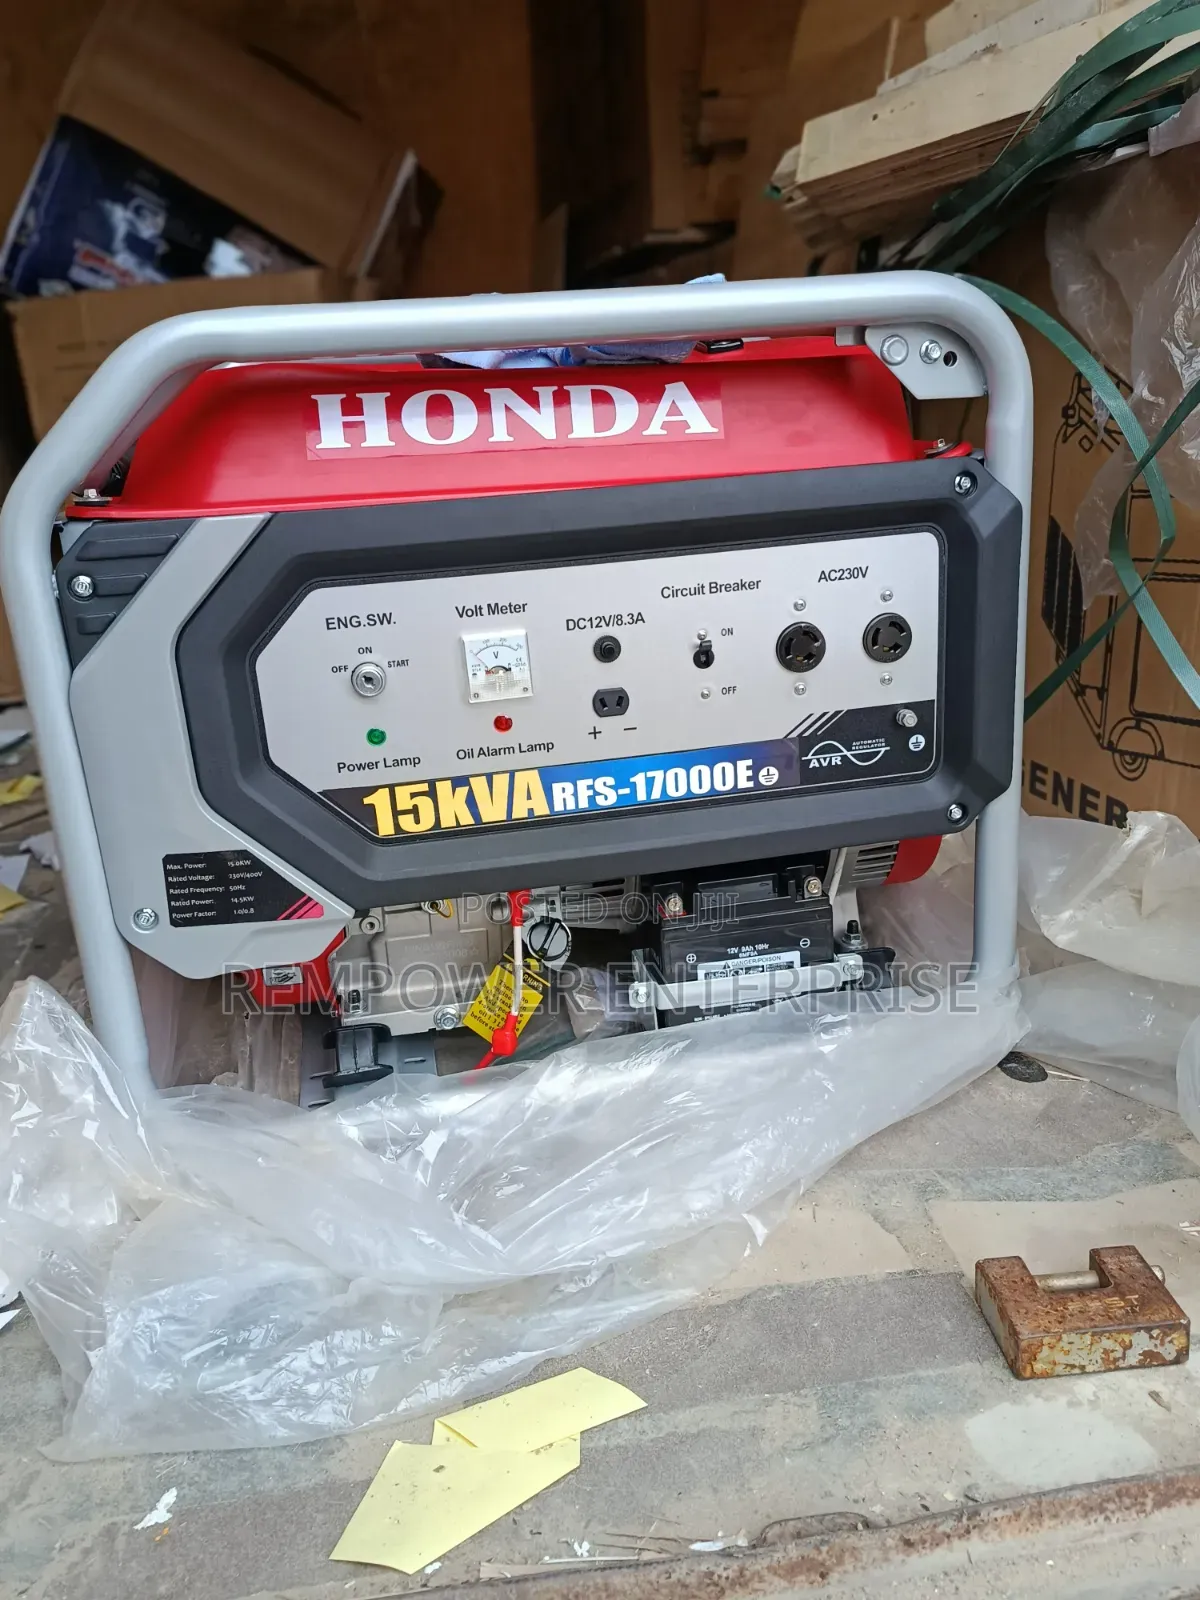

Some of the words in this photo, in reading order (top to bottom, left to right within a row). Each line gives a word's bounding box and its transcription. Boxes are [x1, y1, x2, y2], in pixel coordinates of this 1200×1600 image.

[311, 381, 719, 449] HONDA
[817, 565, 869, 583] AC230V
[660, 582, 706, 599] Circuit
[708, 578, 762, 594] Breaker
[455, 603, 485, 619] Volt
[487, 600, 528, 616] Meter
[325, 612, 397, 630] ENG.SW.
[565, 611, 646, 631] DC12V/8.3A
[720, 627, 734, 637] ON
[357, 645, 373, 655] ON
[493, 650, 499, 660] V
[387, 658, 410, 668] START
[331, 664, 349, 675] OFF
[721, 686, 737, 696] OFF
[851, 742, 886, 750] REGULATOR
[852, 738, 886, 746] AUTOMATIC
[456, 747, 475, 761] Oil
[477, 743, 516, 758] Alarm
[518, 740, 555, 756] Lamp
[337, 758, 381, 774] Power
[383, 754, 421, 769] Lamp
[808, 756, 842, 769] AVR
[362, 769, 550, 837] 15kVA
[551, 758, 754, 812] RFS-17000E
[188, 874, 215, 882] Voltage:
[228, 871, 263, 879] 230V/400V
[189, 886, 225, 894] Frequency:
